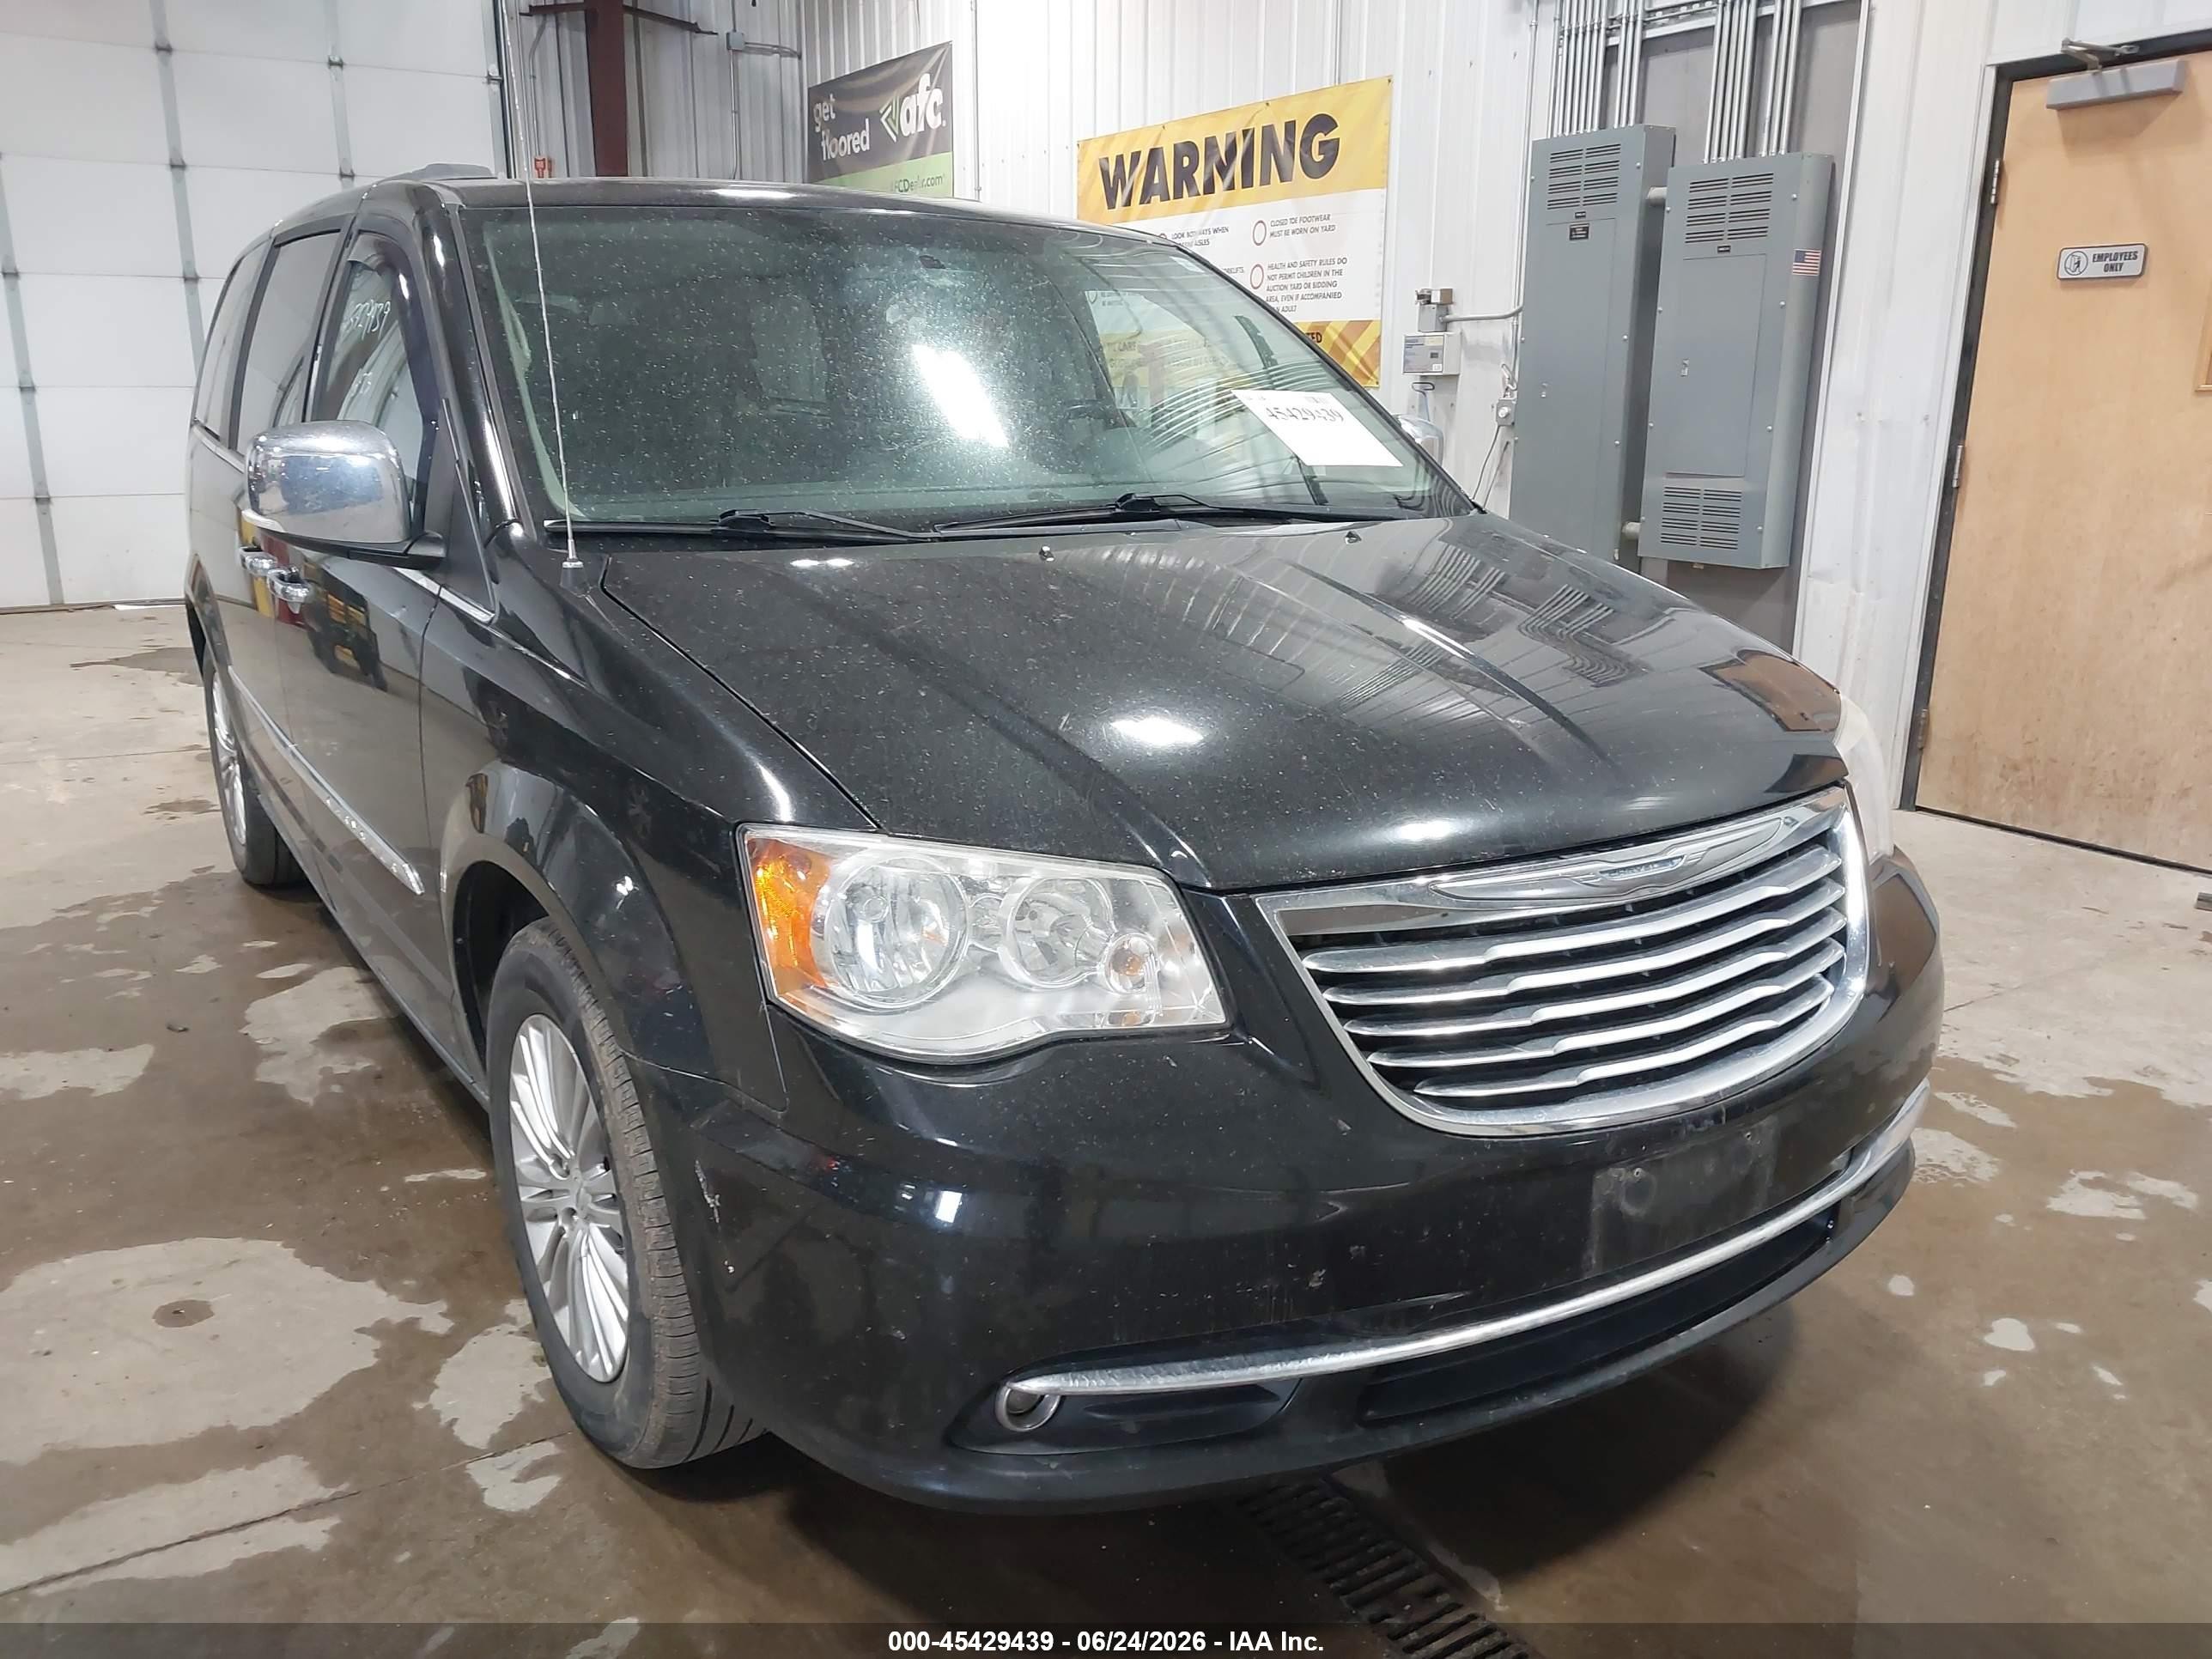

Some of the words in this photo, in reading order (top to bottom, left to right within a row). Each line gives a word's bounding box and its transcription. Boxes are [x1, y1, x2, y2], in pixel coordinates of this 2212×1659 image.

[813, 93, 836, 132] get
[822, 118, 870, 161] floored
[1099, 113, 1340, 210] WARNING
[1299, 214, 1331, 223] FOOTWEAR
[1270, 229, 1283, 238] MUST
[2093, 251, 2138, 263] EMPLOYEES
[1267, 262, 1285, 270] HEALTH
[1299, 259, 1318, 268] SAFETY
[2103, 262, 2124, 273] ONLY
[1297, 270, 1322, 279] CHILDREN
[1312, 280, 1338, 289] BIDDING
[1301, 291, 1342, 301] ACCOMPANIED
